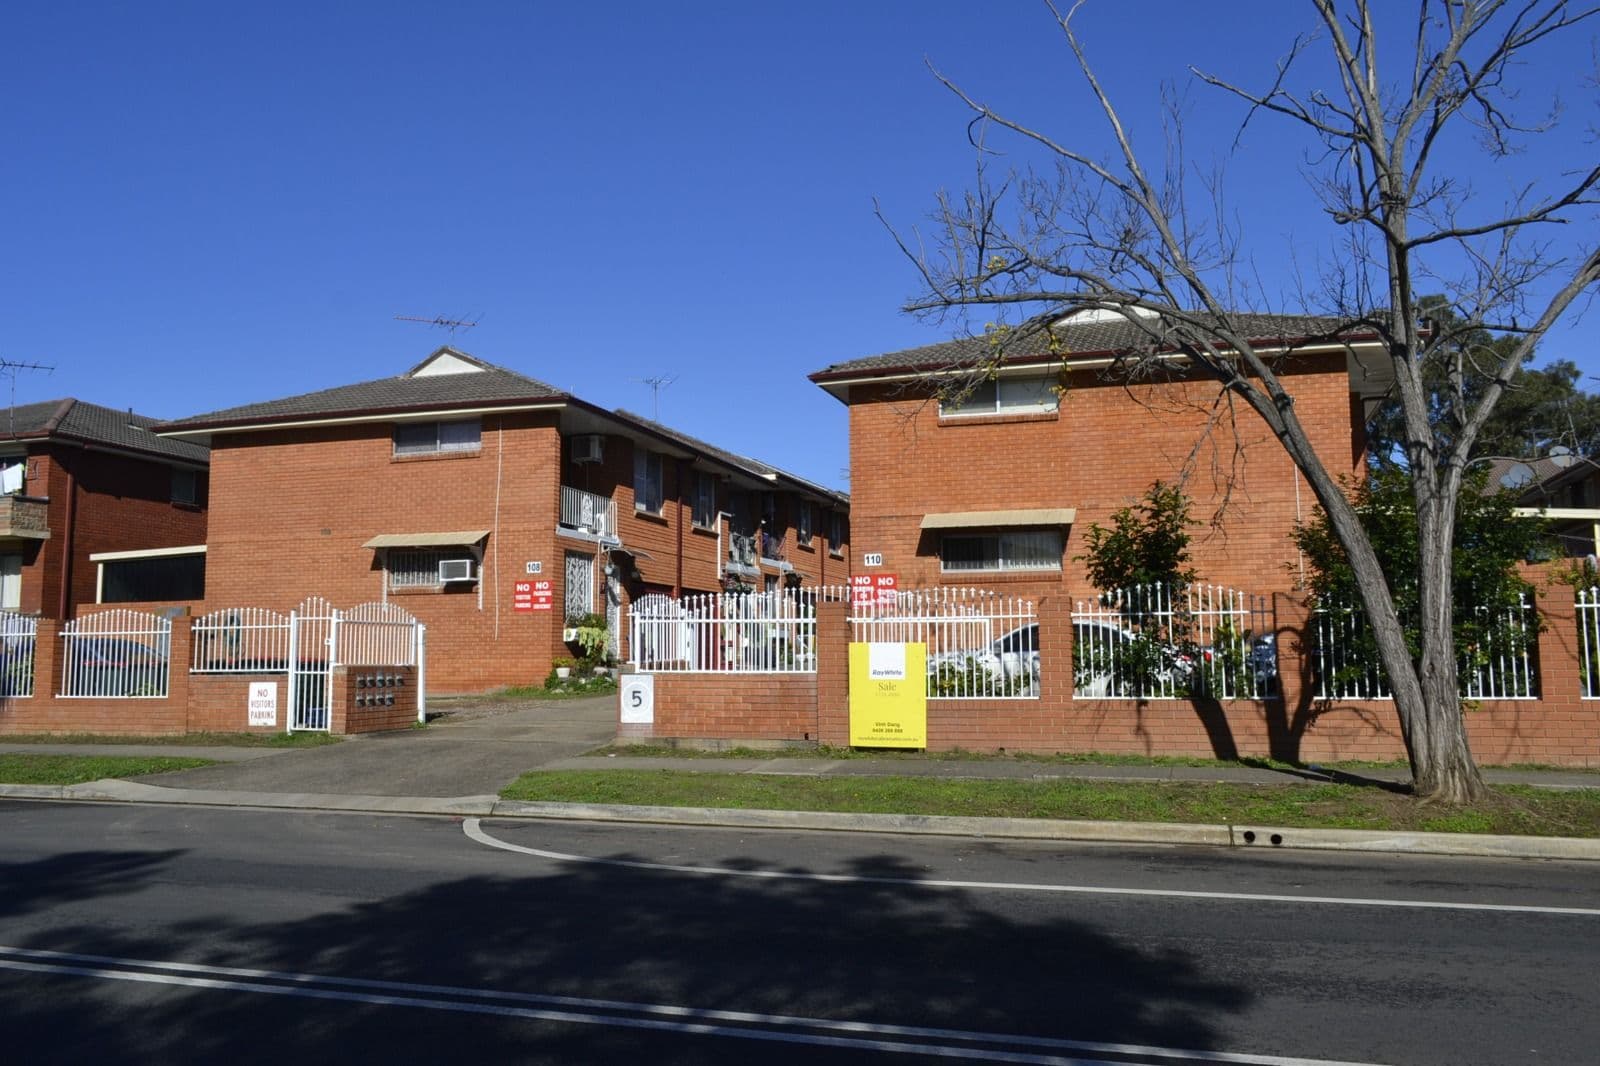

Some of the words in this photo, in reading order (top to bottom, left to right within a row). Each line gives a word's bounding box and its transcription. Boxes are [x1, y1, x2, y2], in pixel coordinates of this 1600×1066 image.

[865, 555, 881, 564] 110
[527, 563, 540, 571] 108
[855, 576, 871, 585] NO
[878, 577, 894, 586] NO
[535, 582, 549, 590] NO
[878, 681, 897, 691] Sale
[257, 689, 269, 698] NO
[632, 690, 642, 707] 5
[250, 700, 275, 709] VISITORS
[250, 710, 275, 720] PARKING
